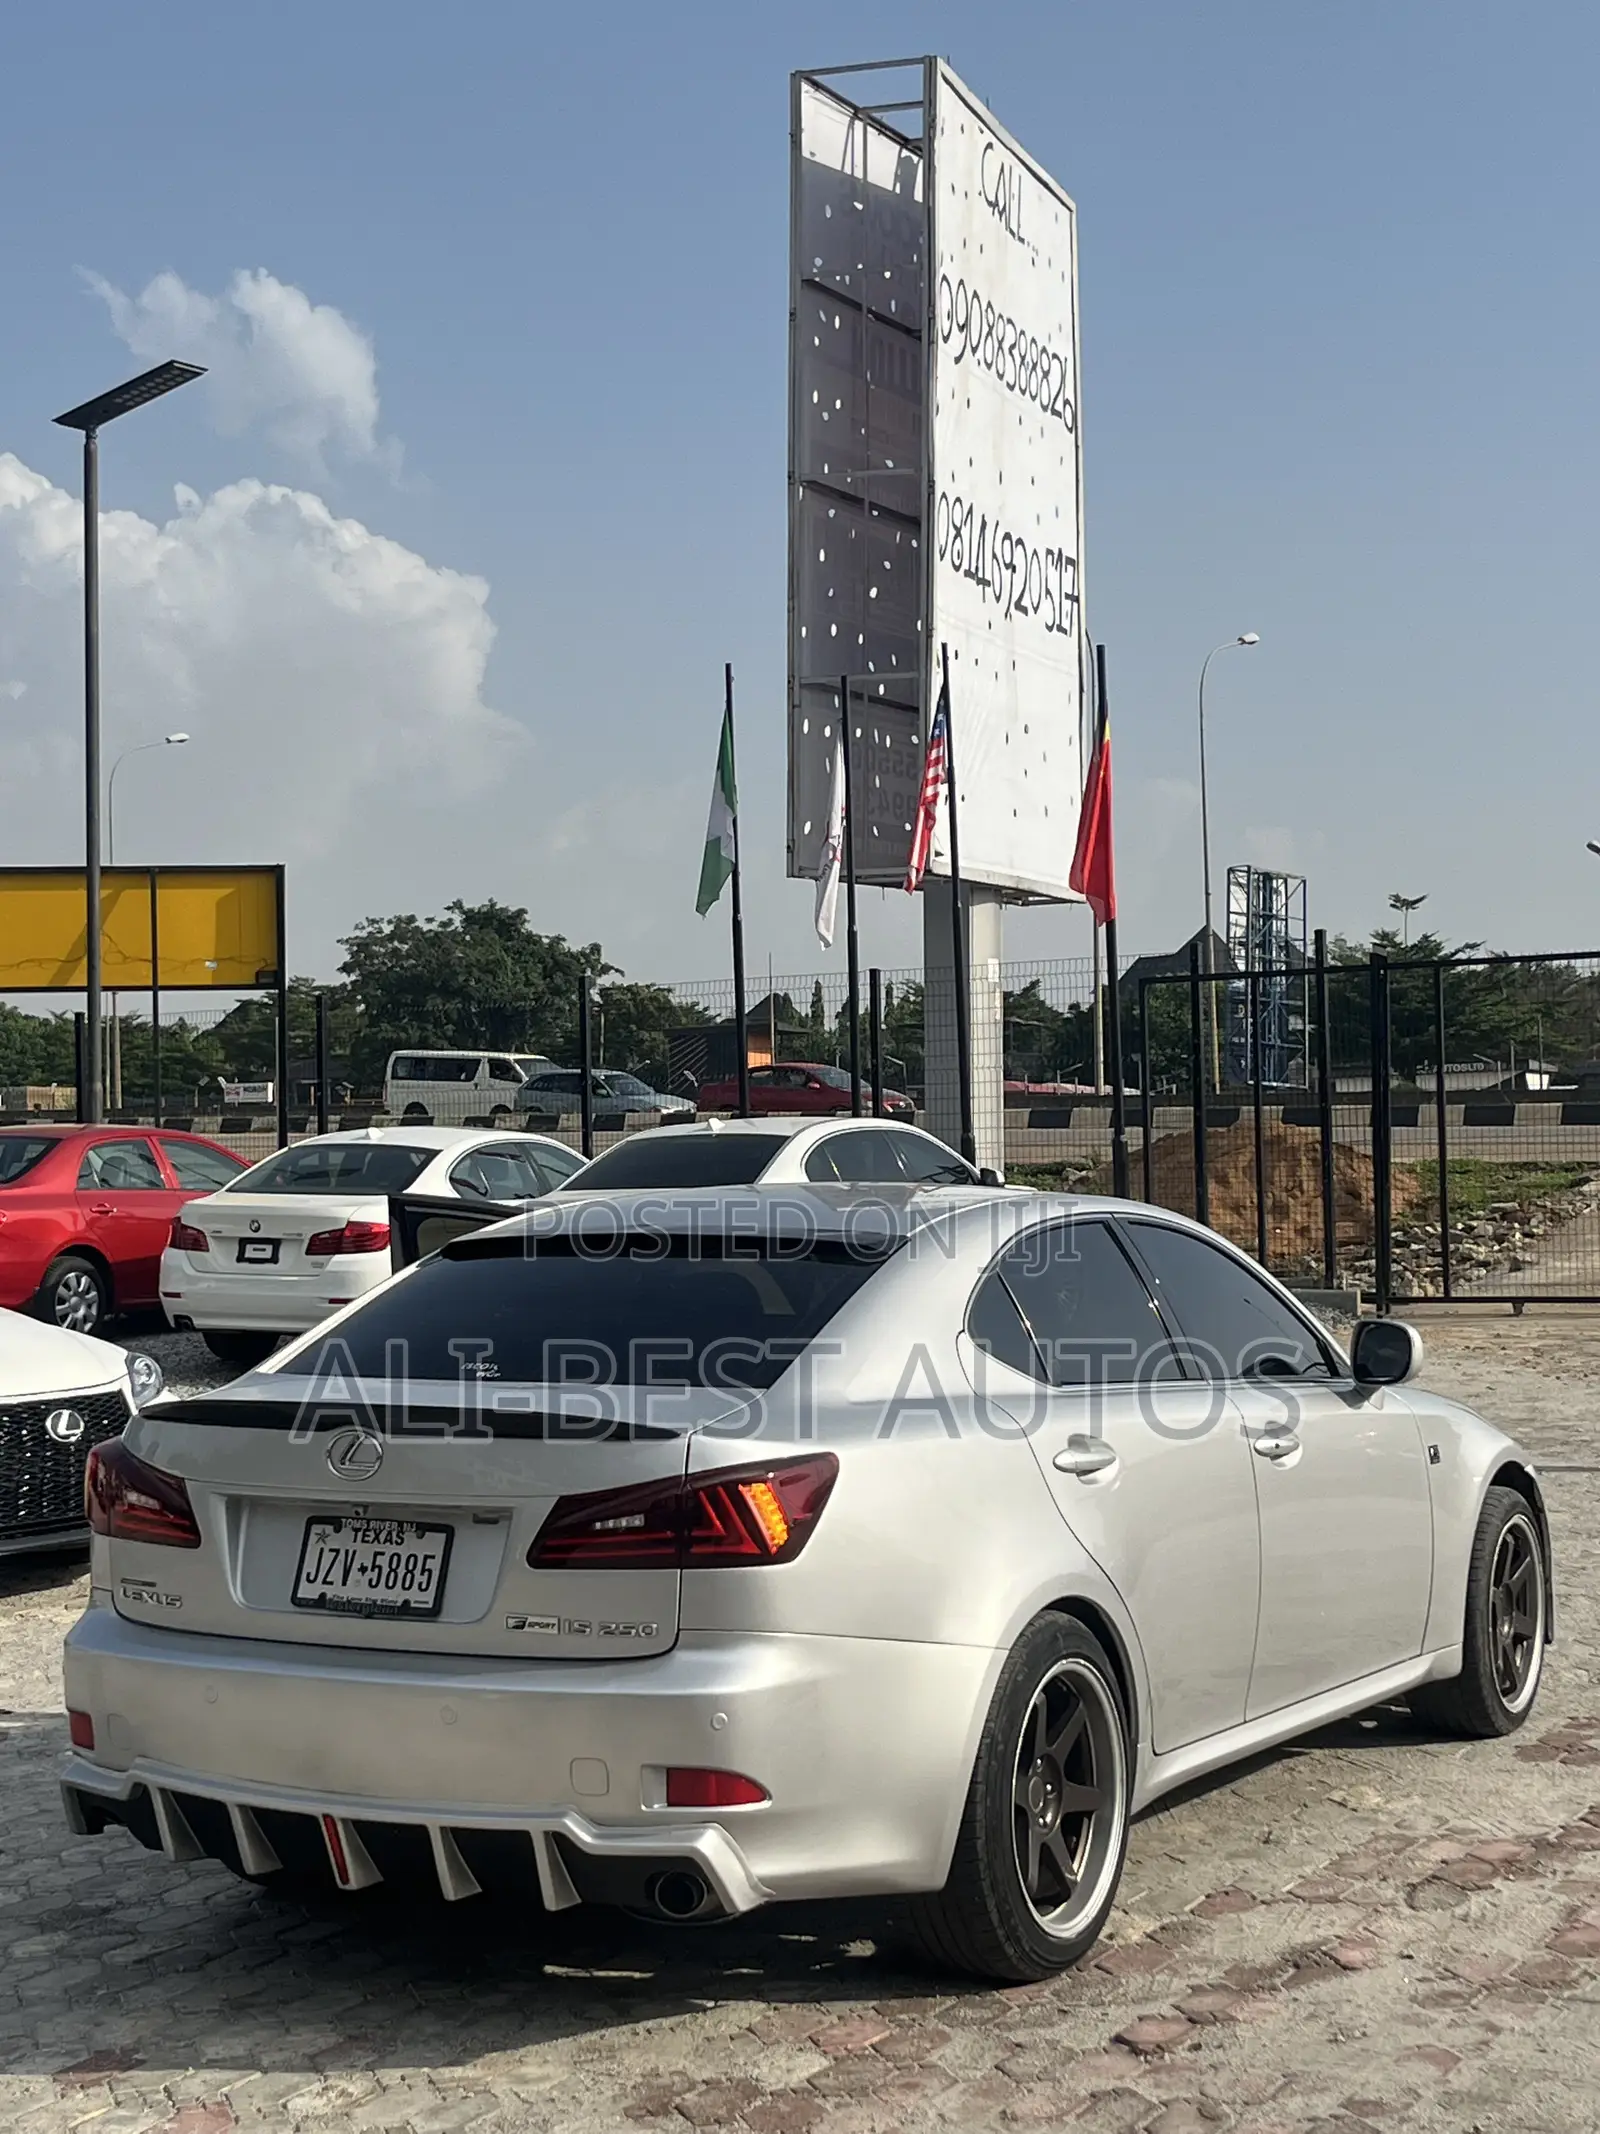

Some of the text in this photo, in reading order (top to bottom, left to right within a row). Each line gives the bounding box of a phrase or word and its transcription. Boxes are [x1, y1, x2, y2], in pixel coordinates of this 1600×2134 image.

[939, 273, 1074, 434] 09088388826
[937, 491, 1079, 637] 08146920517
[341, 1518, 368, 1529] TOMS
[352, 1527, 405, 1546] TEXAS
[120, 1586, 183, 1609] LEXUS
[563, 1618, 592, 1636] IS
[599, 1621, 659, 1637] 250
